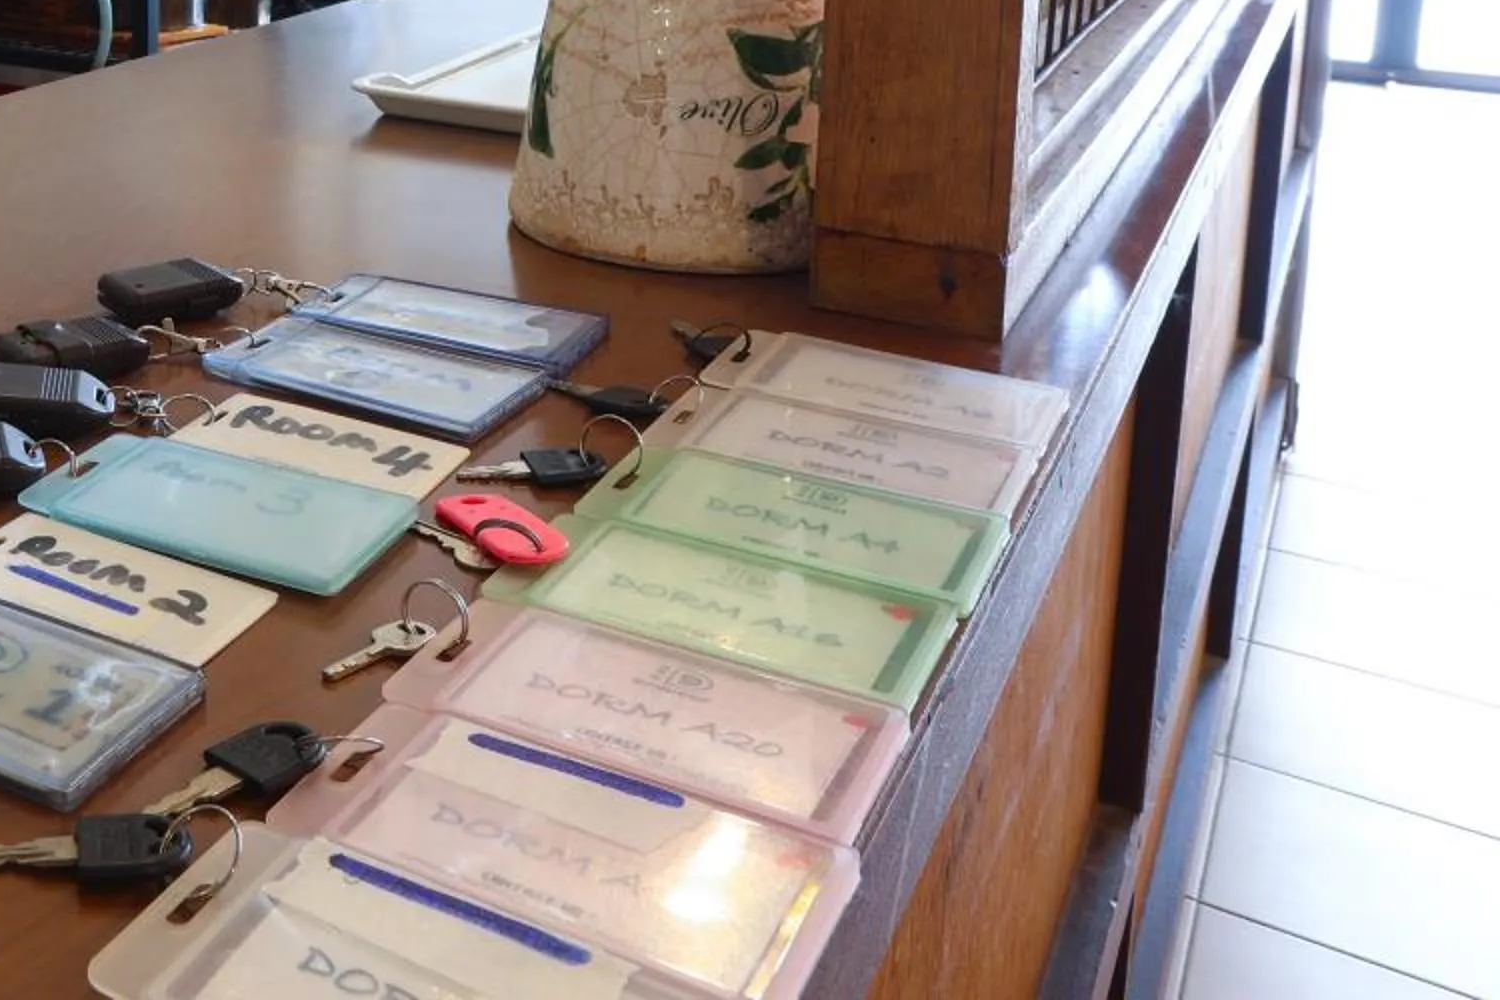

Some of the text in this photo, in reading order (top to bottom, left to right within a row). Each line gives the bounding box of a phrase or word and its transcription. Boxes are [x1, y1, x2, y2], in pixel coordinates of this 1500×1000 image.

[676, 91, 779, 136] Olive
[372, 445, 434, 478] 4
[148, 589, 209, 626] 2
[525, 671, 673, 727] DORM
